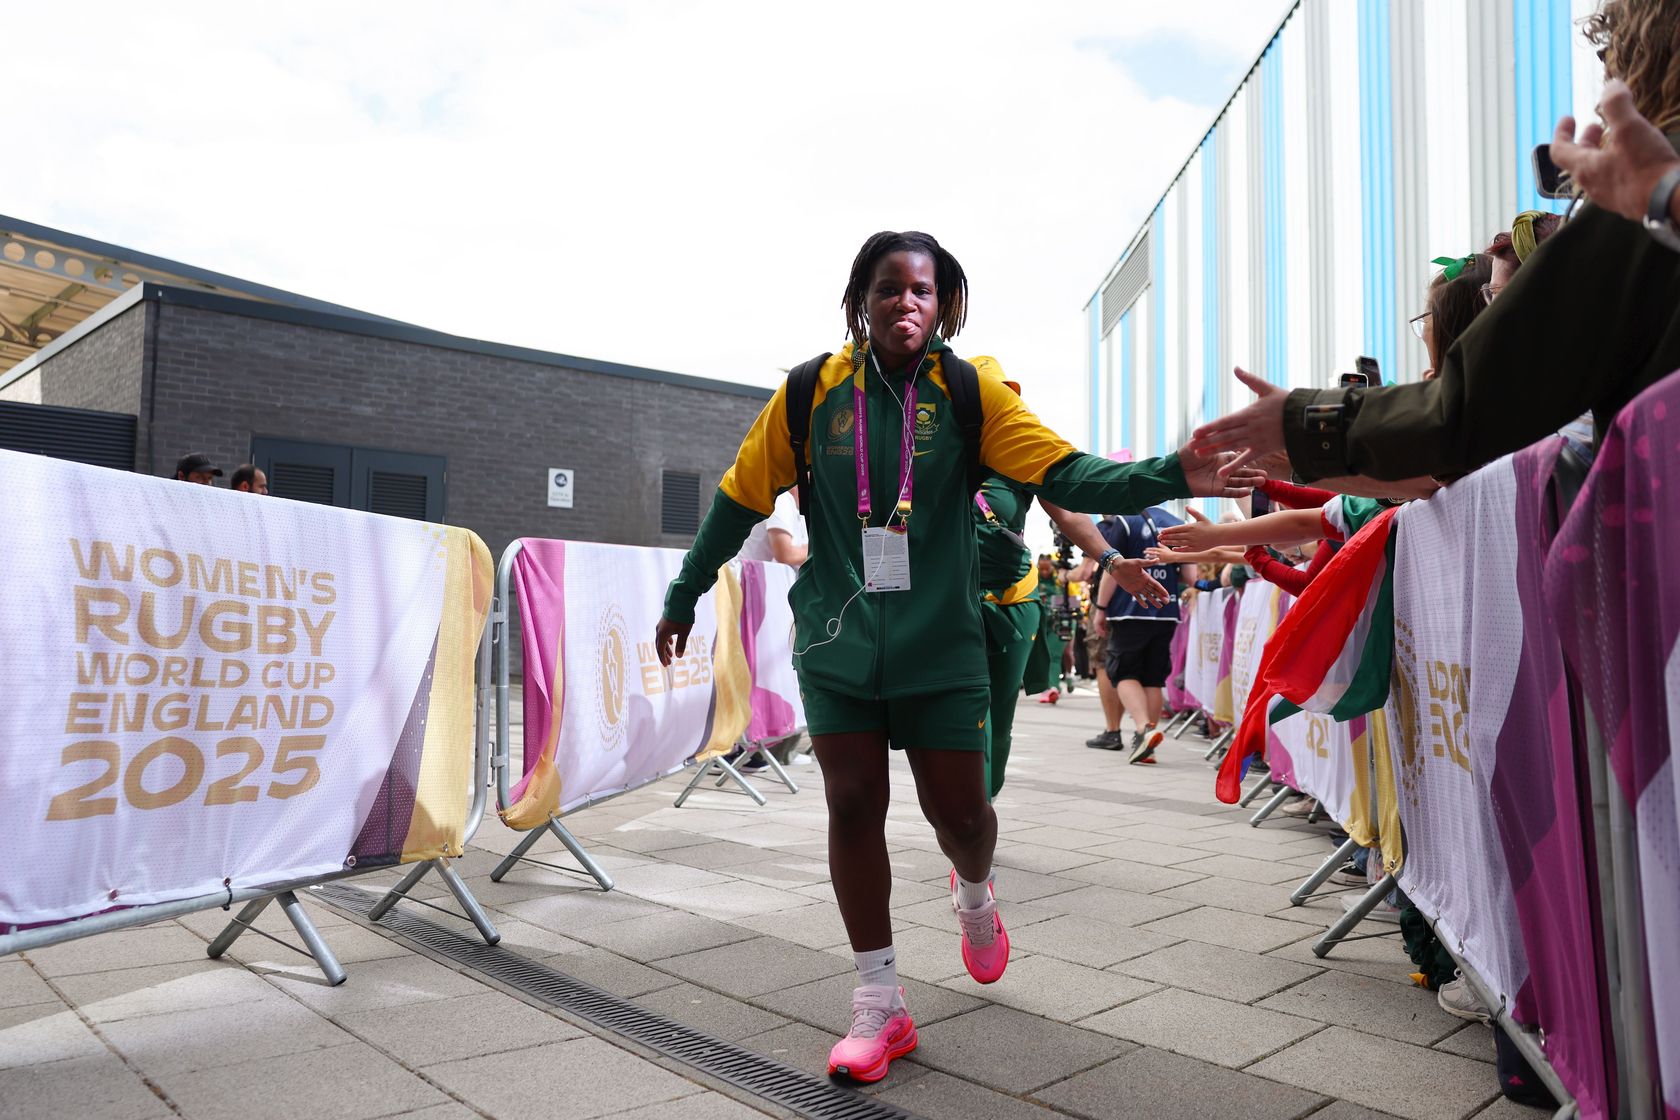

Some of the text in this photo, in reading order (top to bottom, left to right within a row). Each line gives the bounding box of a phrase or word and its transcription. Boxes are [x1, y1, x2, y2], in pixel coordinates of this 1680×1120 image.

[69, 537, 337, 605] WOMEN'S
[73, 585, 336, 657] RUGBY
[76, 651, 336, 690] WORLD CUP
[640, 656, 710, 696] ENG25
[65, 691, 335, 734] ENGLAND
[45, 734, 328, 821] 2025
